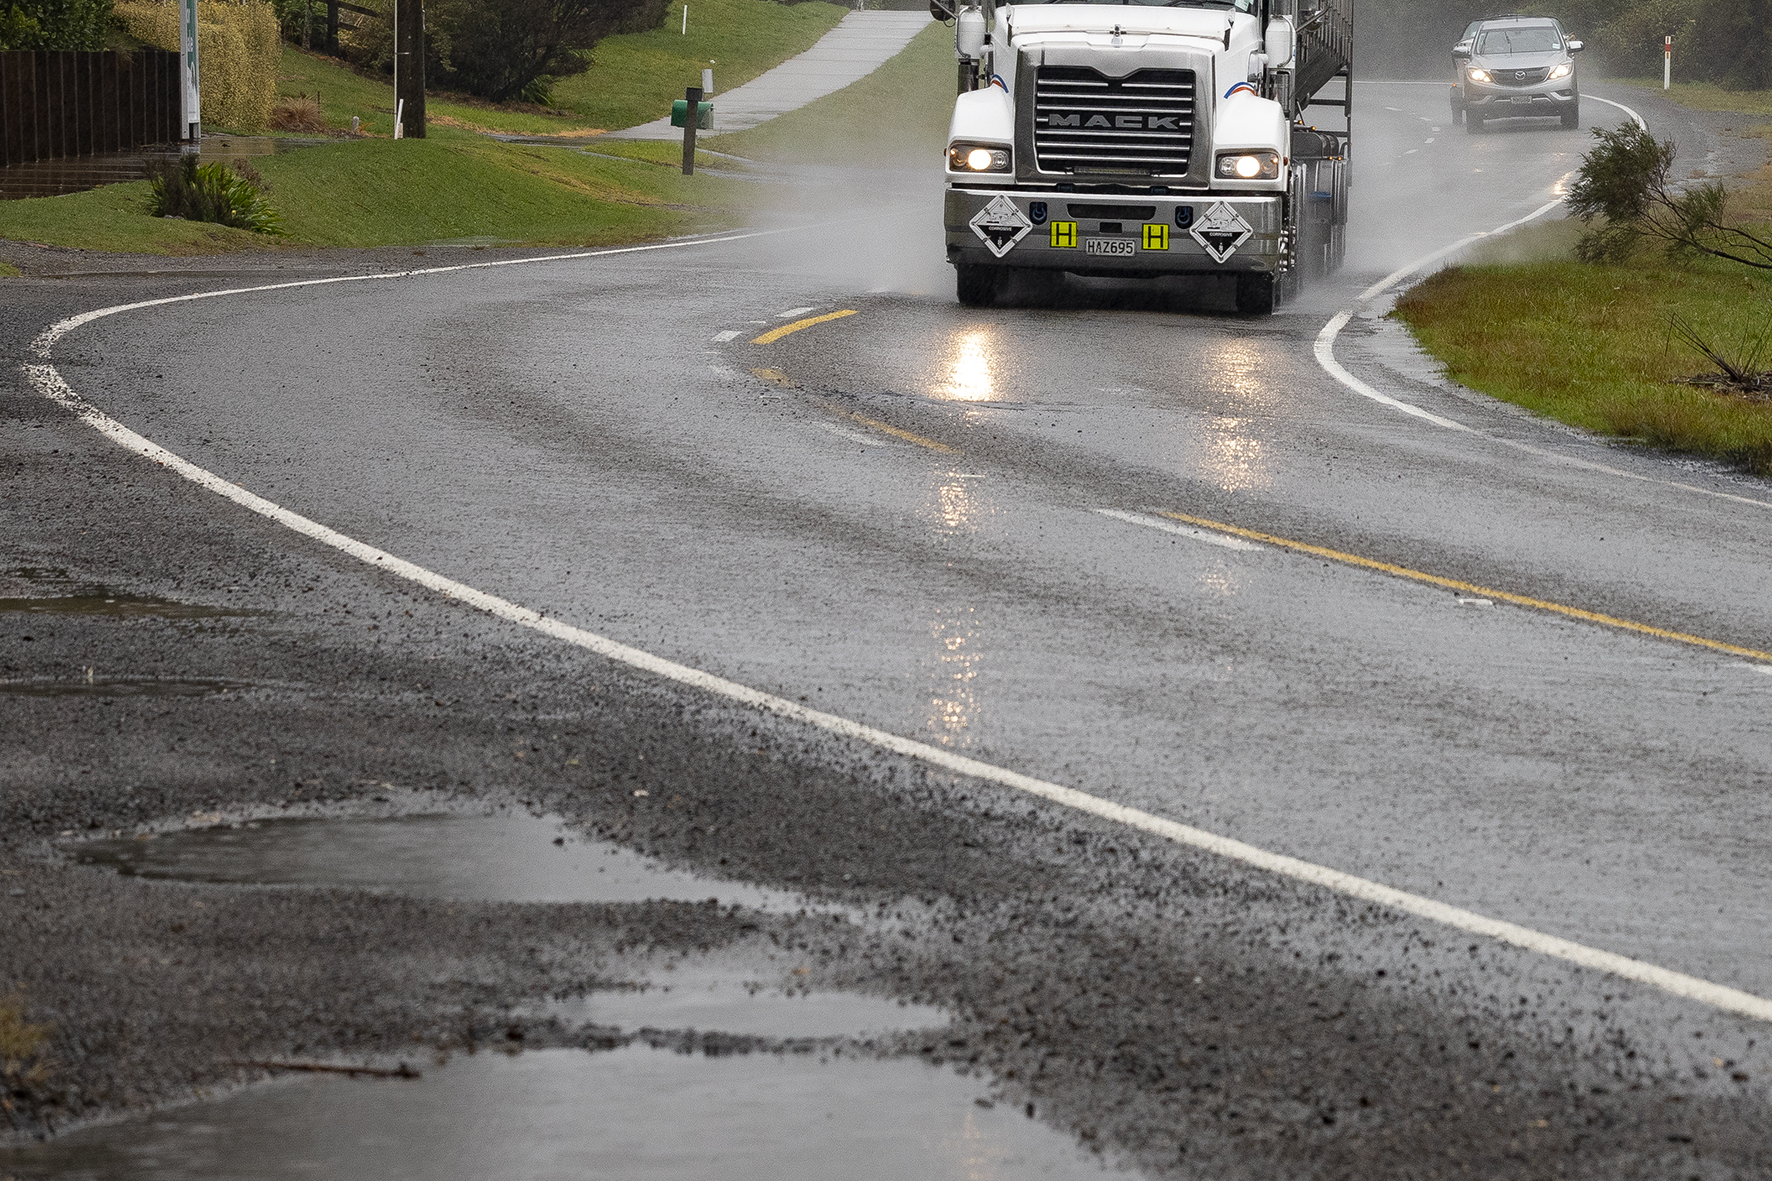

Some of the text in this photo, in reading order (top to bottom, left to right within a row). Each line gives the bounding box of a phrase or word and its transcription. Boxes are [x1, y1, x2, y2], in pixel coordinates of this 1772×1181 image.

[1048, 113, 1179, 130] MACK
[1056, 223, 1072, 246] H
[1147, 225, 1164, 248] H
[1087, 240, 1134, 254] HAZ695
